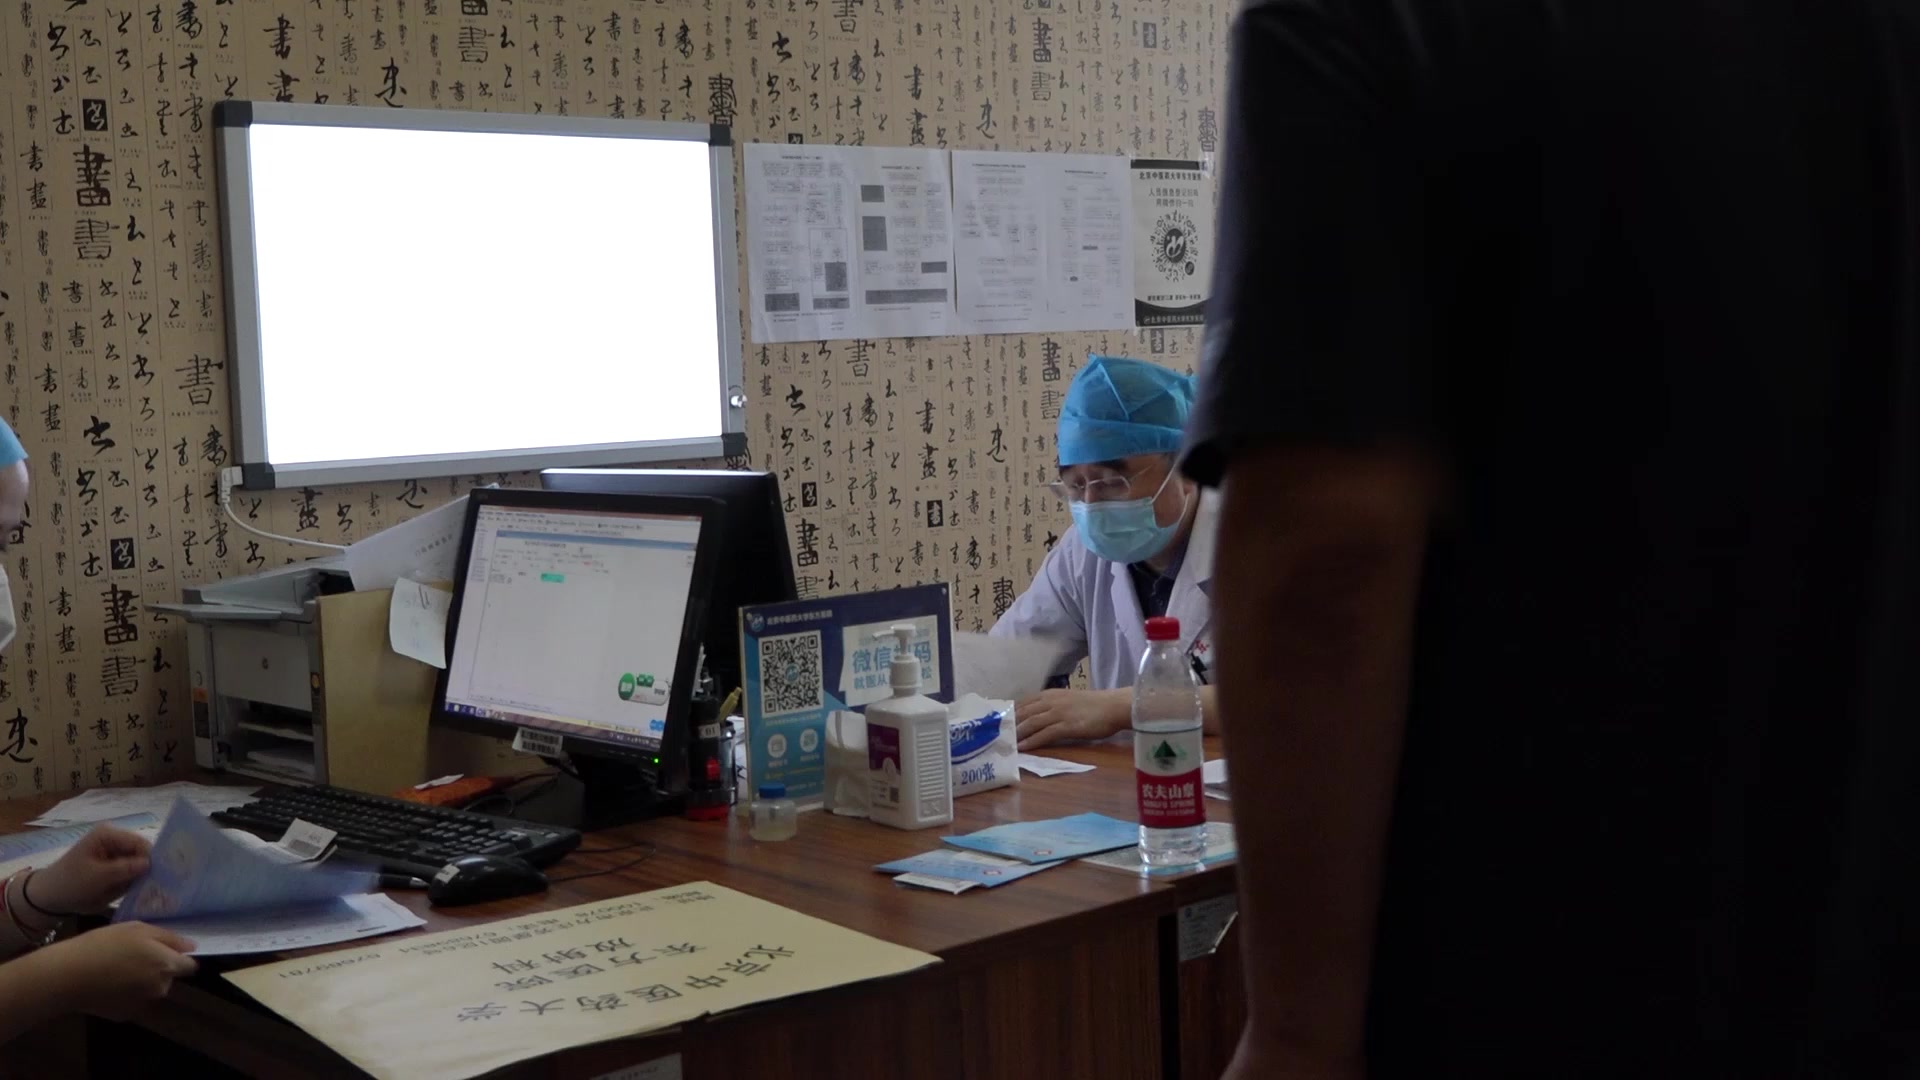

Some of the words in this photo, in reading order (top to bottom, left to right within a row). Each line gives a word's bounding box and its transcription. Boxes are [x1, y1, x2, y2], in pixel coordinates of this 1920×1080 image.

[852, 640, 932, 673] 微信码
[961, 762, 995, 785] 200张
[1142, 782, 1195, 800] 农夫山泉
[491, 936, 639, 974] 放射科
[494, 941, 710, 992] 东方医院
[455, 943, 796, 1023] 北京中医药大学
